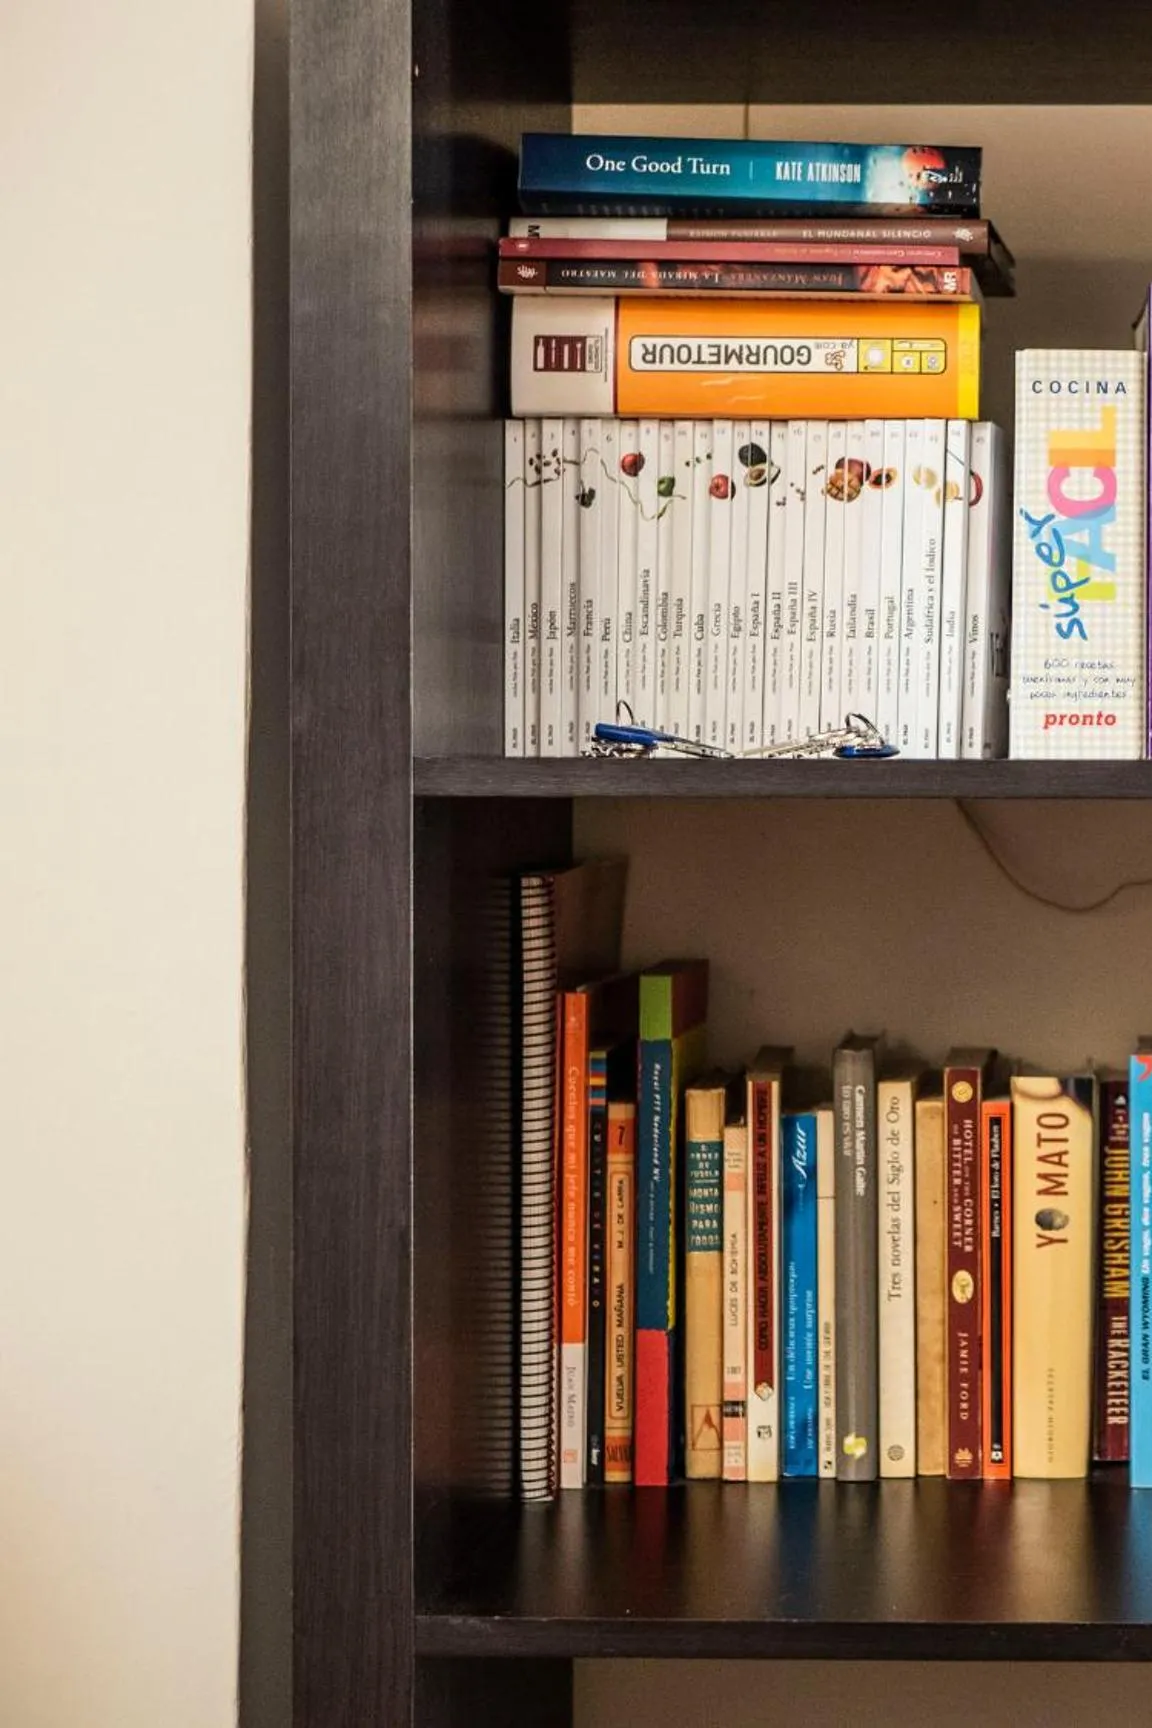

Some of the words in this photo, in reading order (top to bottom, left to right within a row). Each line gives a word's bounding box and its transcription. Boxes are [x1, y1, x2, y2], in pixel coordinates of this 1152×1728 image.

[585, 153, 627, 172] One
[630, 154, 682, 175] Good
[685, 156, 731, 177] Turn
[775, 160, 802, 182] KATE
[807, 161, 861, 184] ATKINSON
[802, 228, 814, 238] EL
[882, 229, 932, 239] SILENCIO
[560, 268, 617, 279] MAESTRO
[640, 342, 812, 367] GOURMETOUR
[1031, 379, 1127, 394] COCINA
[638, 569, 651, 636] Escandinavia
[771, 592, 781, 600] II
[788, 582, 797, 596] III
[808, 590, 818, 602] IV
[527, 603, 539, 640] México
[546, 611, 558, 640] Japón
[566, 582, 577, 637] Marruecos
[583, 599, 594, 637] Francia
[657, 592, 669, 642] Colombia
[711, 603, 722, 637] Grecia
[730, 606, 742, 639] Egipto
[749, 600, 761, 638] España
[770, 603, 782, 641] España
[786, 598, 799, 636] España
[806, 604, 819, 643] España
[825, 609, 837, 638] Rusia
[845, 594, 857, 640] Tailandia
[864, 609, 876, 639] Brasil
[884, 596, 897, 640] Portugal
[903, 588, 916, 640] Argentina
[945, 611, 957, 638] India
[509, 618, 521, 644] Italia
[622, 611, 633, 644] China
[694, 613, 705, 641] Cuba
[968, 614, 980, 644] Vinos
[1044, 657, 1069, 670] 600
[1043, 710, 1117, 730] pronto
[855, 1084, 867, 1128] Carmen
[885, 1096, 901, 1124] Oro
[791, 1120, 807, 1179] Azur
[885, 1131, 901, 1146] de
[963, 1119, 974, 1161] HOTEL
[1035, 1112, 1069, 1197] MATO
[885, 1151, 904, 1186] Siglo
[951, 1138, 963, 1185] BITTER
[1103, 1145, 1131, 1197] JOHN
[615, 1211, 625, 1225] DE
[885, 1190, 901, 1212] del
[692, 1219, 719, 1229] PARA
[951, 1205, 963, 1248] SWEET
[963, 1198, 975, 1252] CORNER
[886, 1217, 901, 1267] novelas
[1103, 1203, 1131, 1298] GRISHAM
[886, 1273, 901, 1302] Tres
[1141, 1277, 1151, 1331] WYOMING
[612, 1282, 625, 1328] MAÑANA
[1110, 1315, 1129, 1335] THE
[614, 1334, 625, 1368] USTED
[957, 1331, 970, 1373] JAMIE
[1141, 1333, 1150, 1365] GRAN
[1106, 1338, 1129, 1425] RACKETEER
[1141, 1367, 1150, 1382] EL
[958, 1381, 970, 1421] FORD
